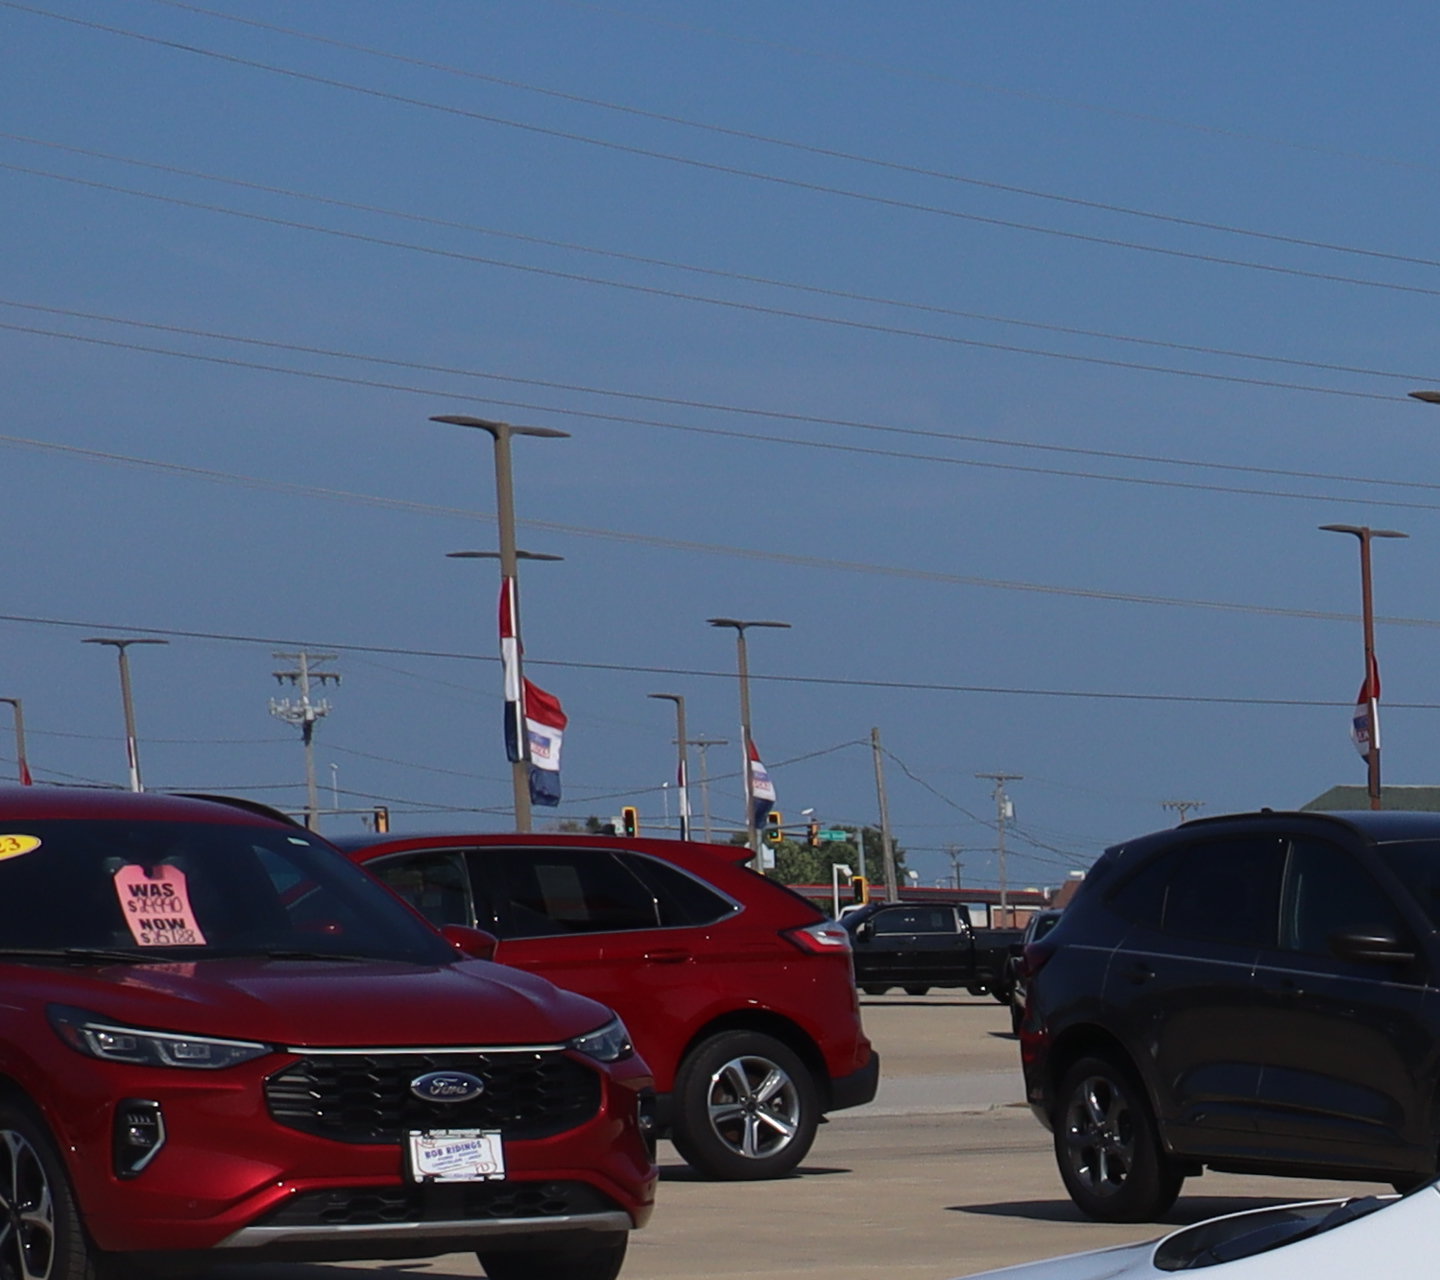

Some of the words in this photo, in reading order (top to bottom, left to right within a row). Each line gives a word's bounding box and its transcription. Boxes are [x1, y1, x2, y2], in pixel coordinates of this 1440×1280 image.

[127, 883, 174, 897] WAS
[139, 918, 185, 931] NOW
[424, 1148, 443, 1160] BOB
[446, 1140, 482, 1155] RIDINGS
